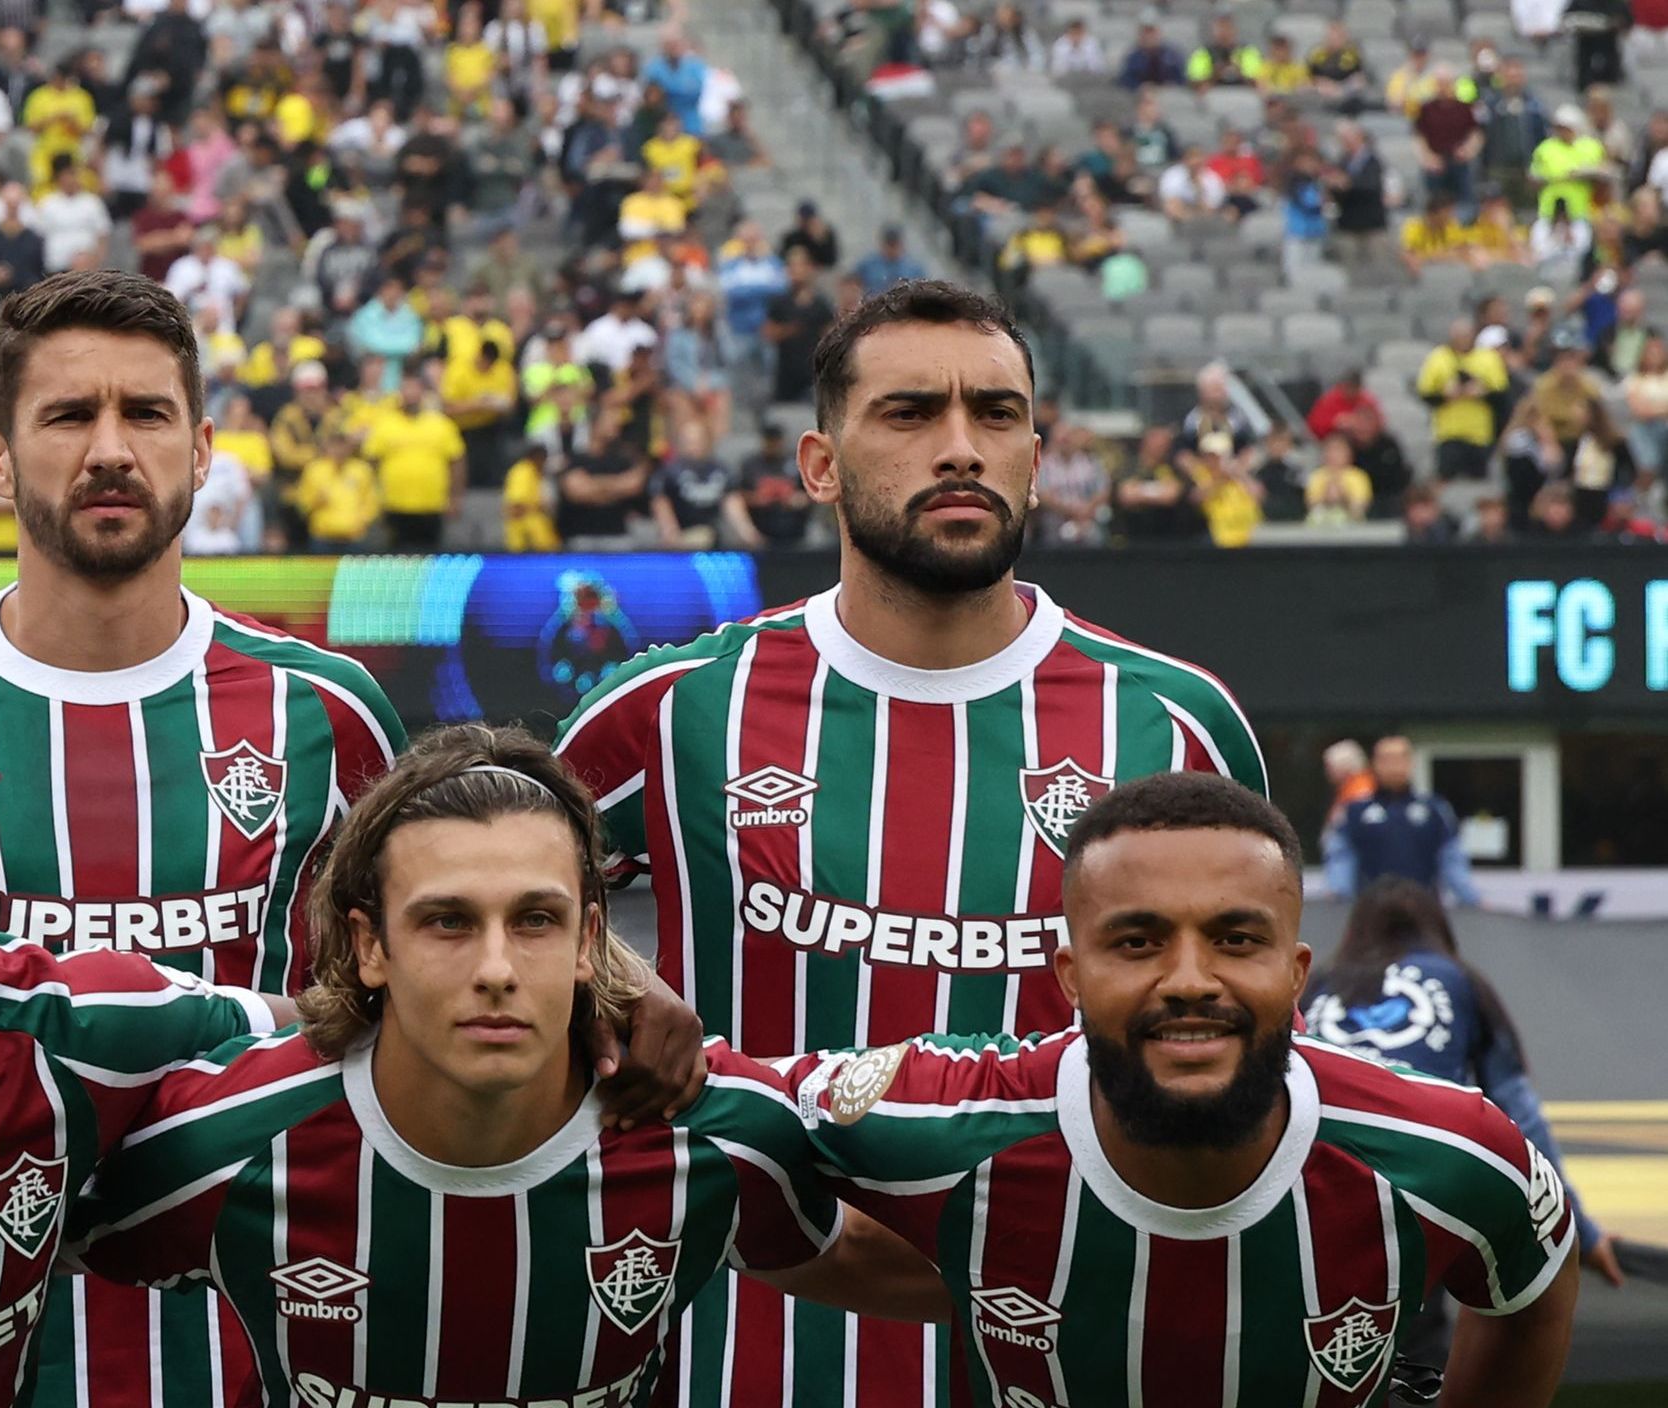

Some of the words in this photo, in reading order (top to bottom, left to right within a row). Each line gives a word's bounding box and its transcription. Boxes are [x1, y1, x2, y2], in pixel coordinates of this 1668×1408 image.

[1506, 578, 1615, 692] FC
[733, 807, 806, 827] umbro
[280, 1300, 361, 1321] umbro
[979, 1320, 1052, 1351] umbro
